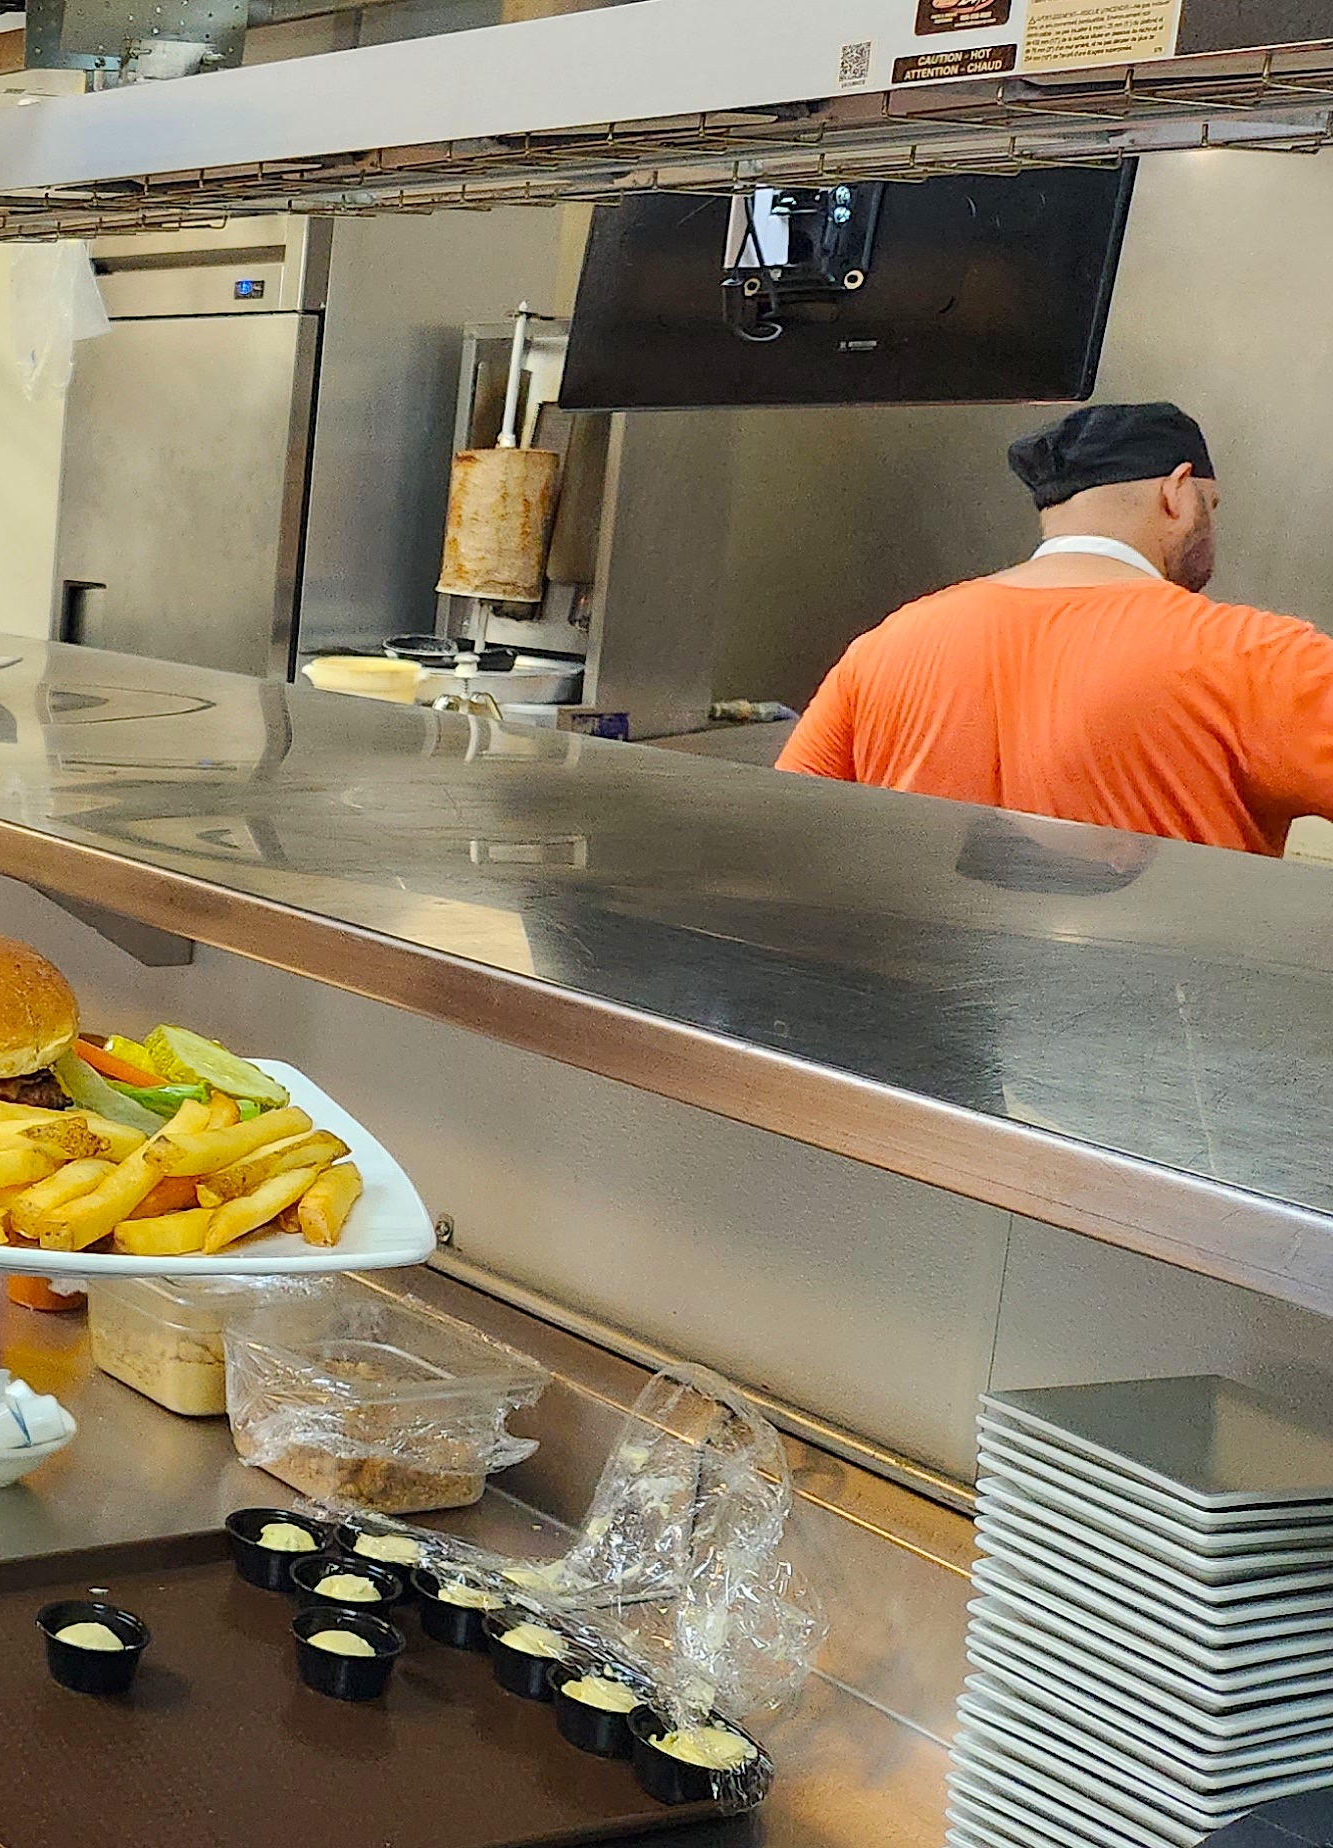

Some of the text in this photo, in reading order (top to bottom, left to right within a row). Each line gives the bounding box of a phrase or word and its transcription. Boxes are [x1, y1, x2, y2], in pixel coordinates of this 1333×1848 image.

[917, 52, 963, 67] CAUTION
[970, 48, 993, 60] HOT
[904, 64, 959, 80] ATTENTION
[967, 60, 1003, 74] CHAUD
